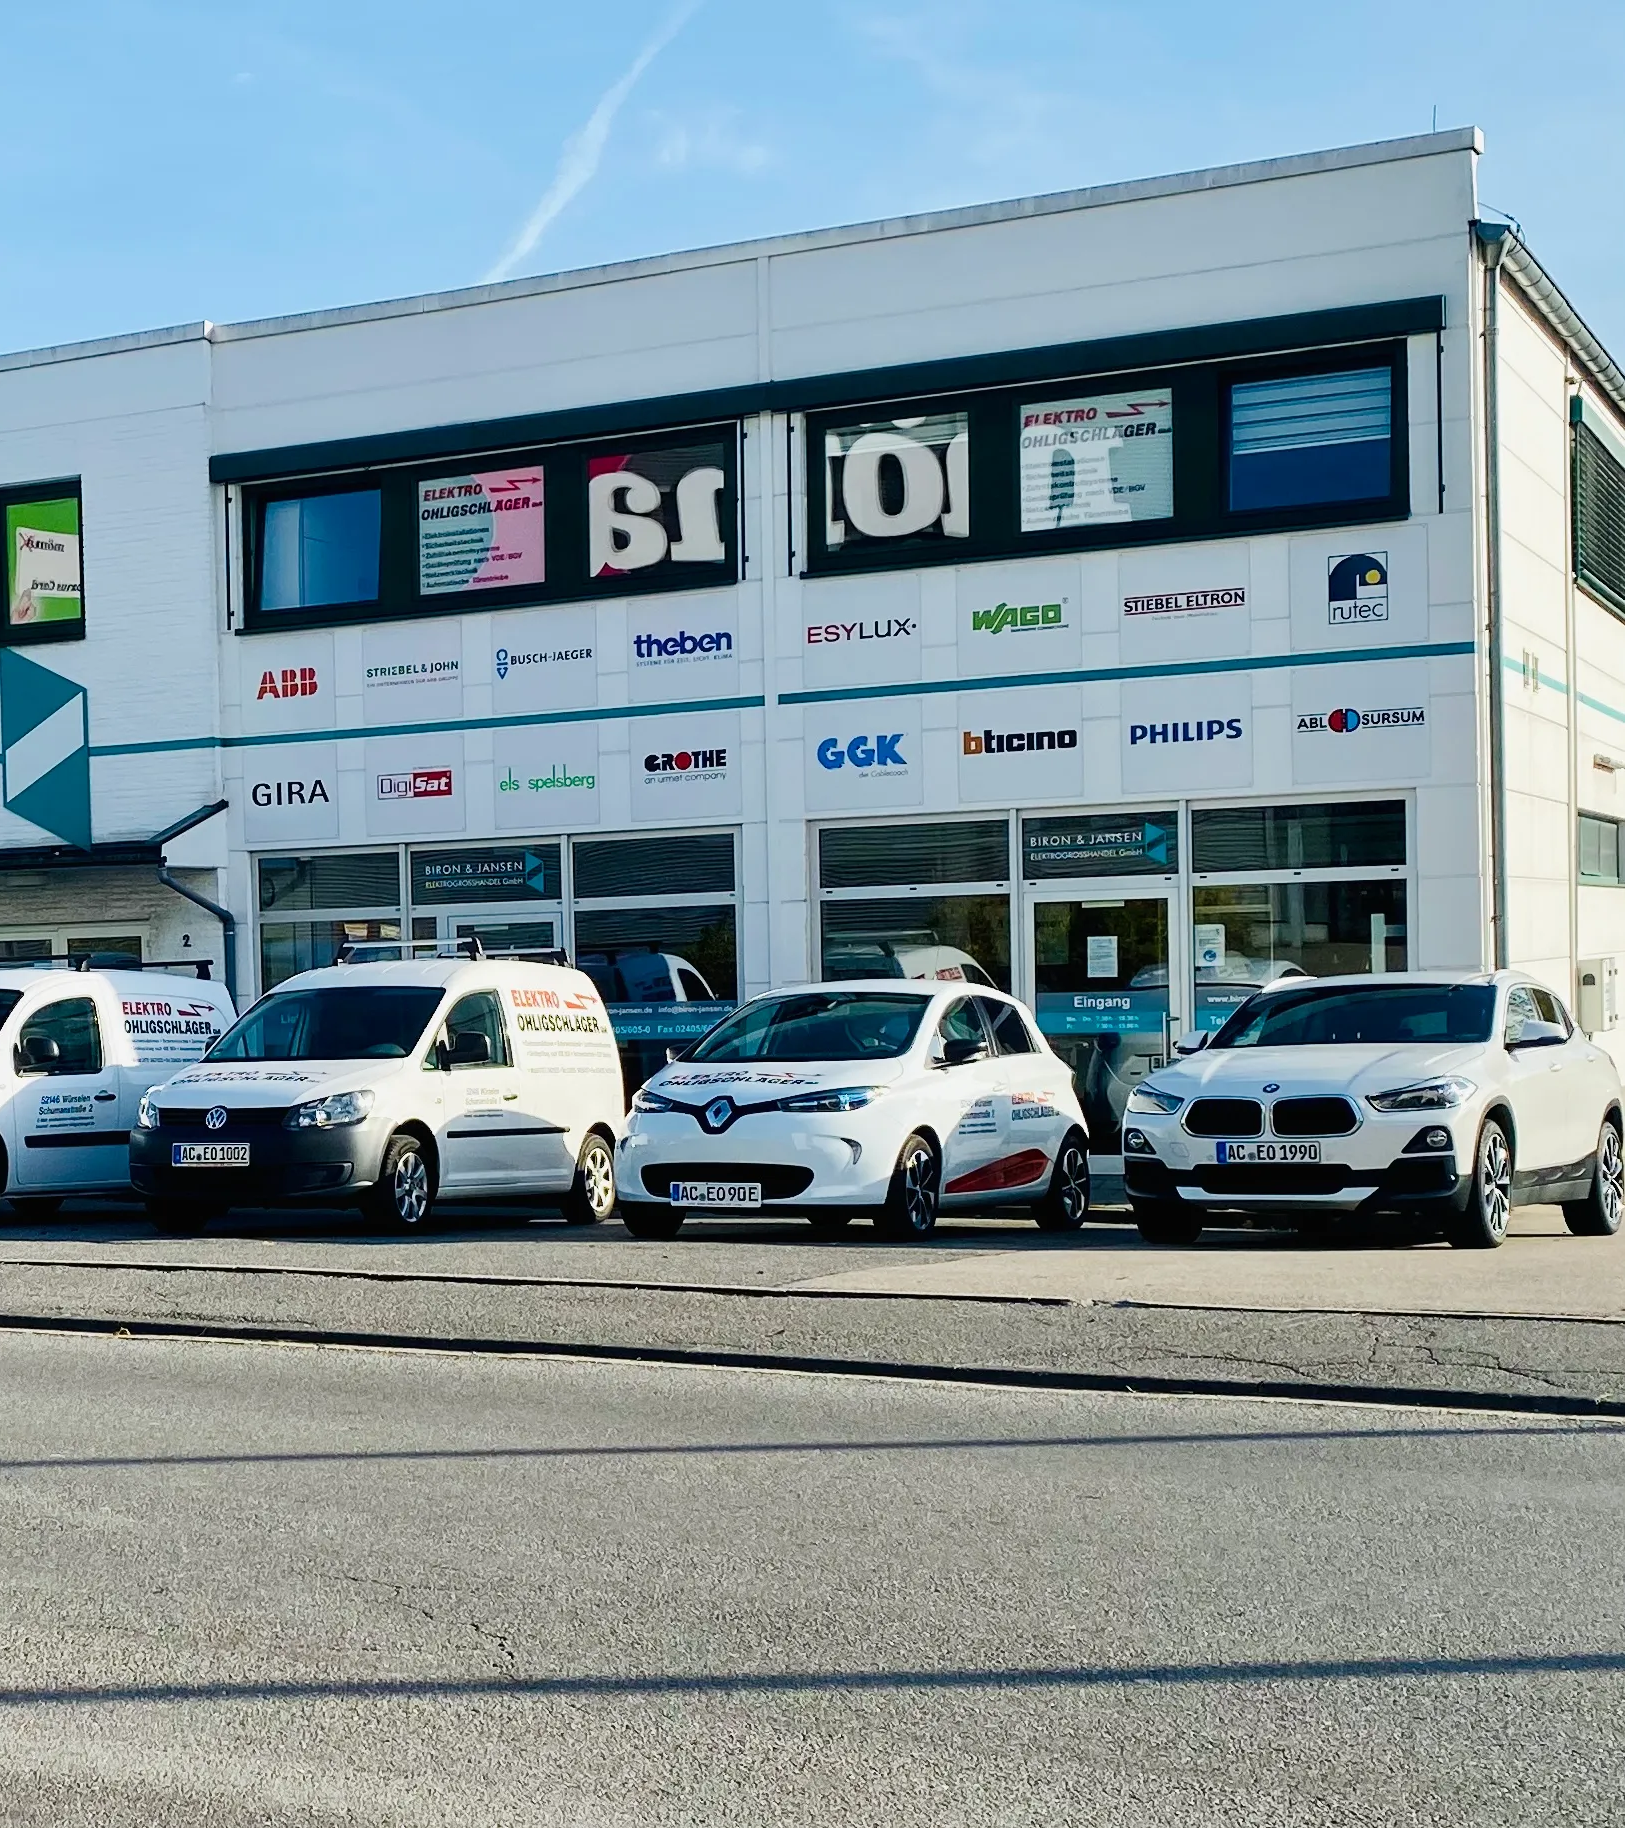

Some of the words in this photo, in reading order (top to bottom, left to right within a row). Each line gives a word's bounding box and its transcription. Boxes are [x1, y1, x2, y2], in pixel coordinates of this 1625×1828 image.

[1023, 407, 1098, 428] ELEKTRO
[423, 483, 483, 501] ELEKTRO
[421, 496, 531, 520] OHLIGSCHLÄGER
[1124, 597, 1183, 613] STIEBEL
[1186, 591, 1245, 607] ELTRON
[1332, 602, 1384, 621] rutec
[972, 602, 1062, 635] WAGO
[633, 631, 733, 658] theben
[510, 648, 593, 665] BUSCH-JAEGER
[366, 666, 419, 678] STRIEBEL
[420, 664, 428, 673] &
[429, 660, 459, 672] JOHN
[257, 667, 318, 700] ABB
[1297, 717, 1327, 730] ABL
[1361, 710, 1425, 726] SURSUM
[1130, 718, 1243, 745] PHILIPS
[816, 734, 908, 770] GGK
[963, 729, 1078, 756] bticino
[644, 748, 727, 773] GROTHE
[499, 766, 520, 791] els
[528, 763, 595, 792] spelsberg
[644, 776, 656, 785] an
[684, 772, 727, 784] company
[251, 779, 330, 807] GIRA
[1030, 835, 1071, 847] BIRON
[1076, 834, 1085, 844] &
[1089, 831, 1142, 845] JANSEN
[425, 864, 461, 876] BIRON
[465, 863, 473, 874] &
[476, 861, 523, 873] JANSEN
[182, 933, 192, 948] 2
[510, 989, 560, 1009] ELEKTRO
[1073, 996, 1131, 1010] Eingang
[122, 1002, 172, 1016] ELEKTRO
[124, 1020, 212, 1035] OHLIGSCHLÄGER
[517, 1014, 600, 1033] OHLIGSCHLÄGER
[657, 1025, 673, 1033] Fax
[182, 1147, 196, 1161] AC
[203, 1147, 217, 1160] EO
[219, 1147, 248, 1160] 1002
[1228, 1144, 1246, 1160] AC
[1256, 1144, 1276, 1160] EO
[1279, 1144, 1318, 1160] 1990
[681, 1186, 699, 1201] AC
[707, 1186, 726, 1201] EO
